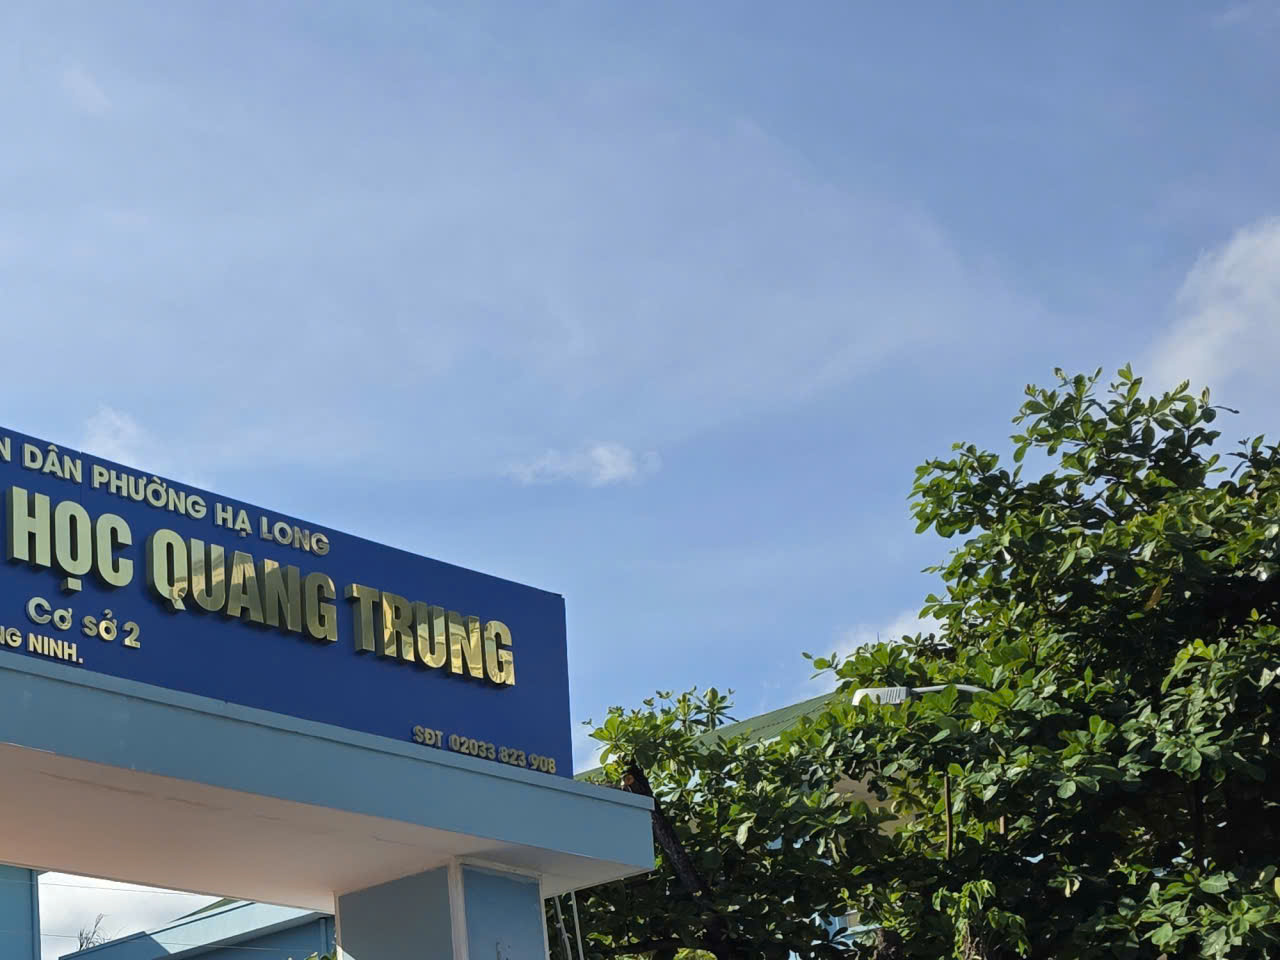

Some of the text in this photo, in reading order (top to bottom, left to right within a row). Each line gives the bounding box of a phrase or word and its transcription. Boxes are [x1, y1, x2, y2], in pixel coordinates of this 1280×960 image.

[23, 444, 83, 484] DÂN
[92, 464, 207, 519] PHƯỜNG
[215, 502, 253, 537] HẠ
[260, 516, 330, 556] LONG
[7, 485, 133, 592] HỌC
[146, 528, 338, 642] QUANG
[345, 583, 516, 686] TRUNG
[26, 596, 141, 649] Cơ sở 2
[27, 632, 84, 664] NINH.
[413, 725, 556, 774] SĐT 02033 823 908
